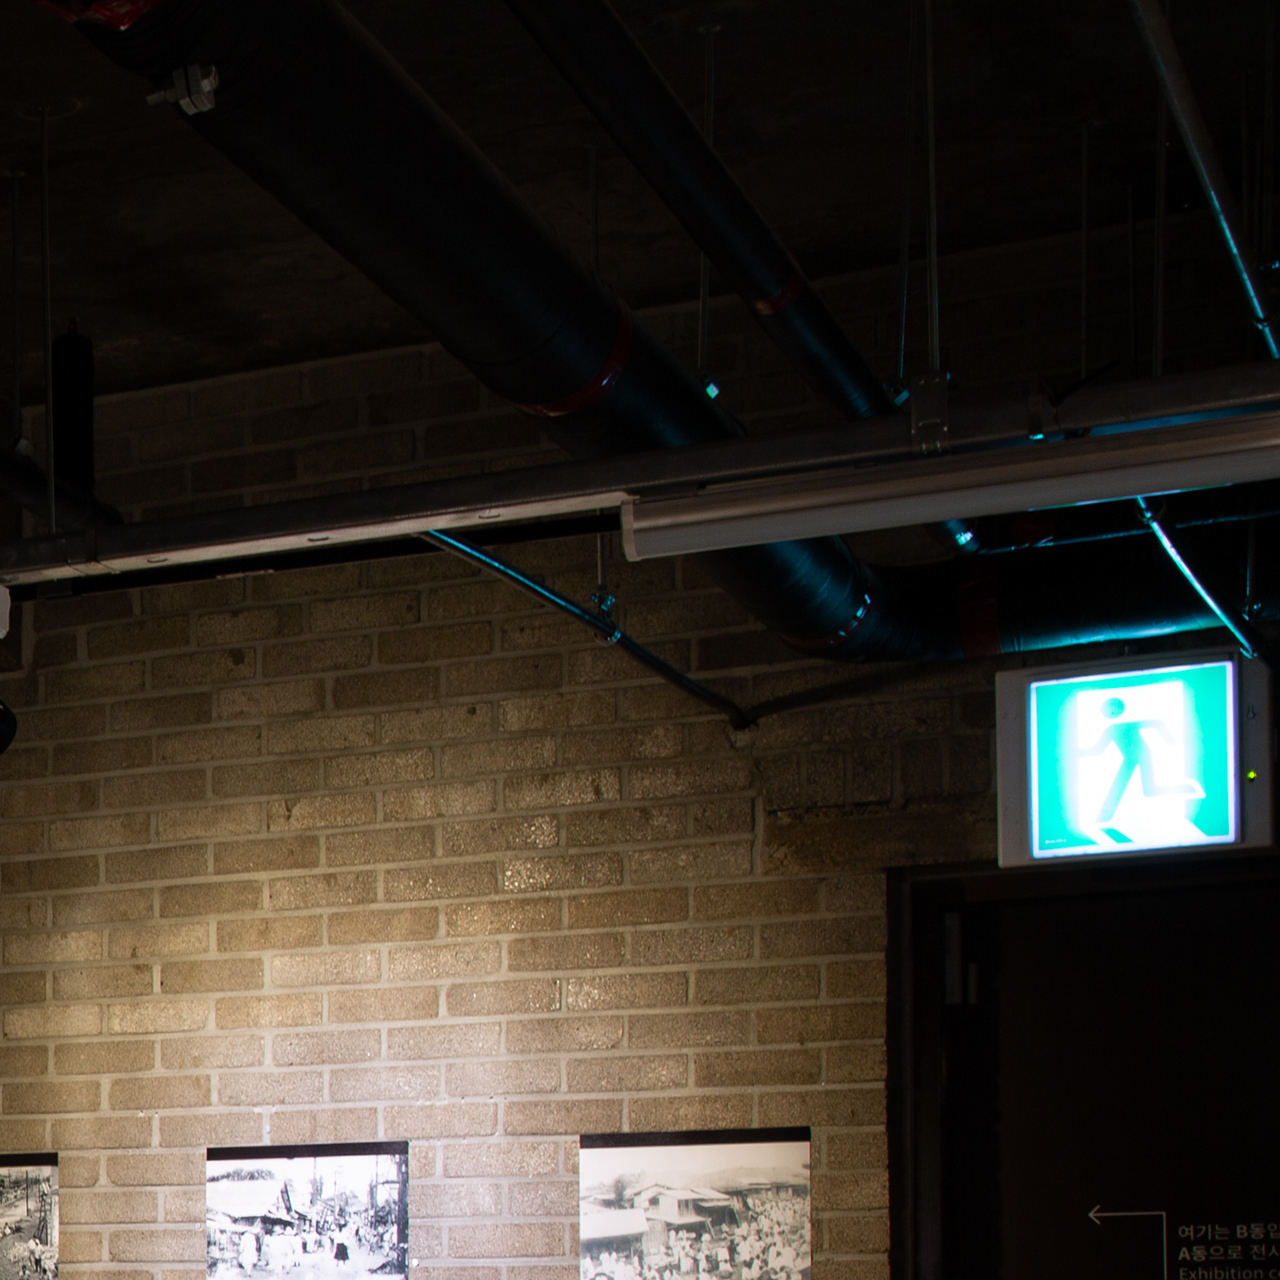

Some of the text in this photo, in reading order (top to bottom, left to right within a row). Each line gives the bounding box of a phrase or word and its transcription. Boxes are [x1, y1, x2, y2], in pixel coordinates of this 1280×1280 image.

[1178, 1224, 1230, 1241] 여기는
[1177, 1244, 1243, 1262] A동으로
[1178, 1266, 1280, 1280] Exhibition c
